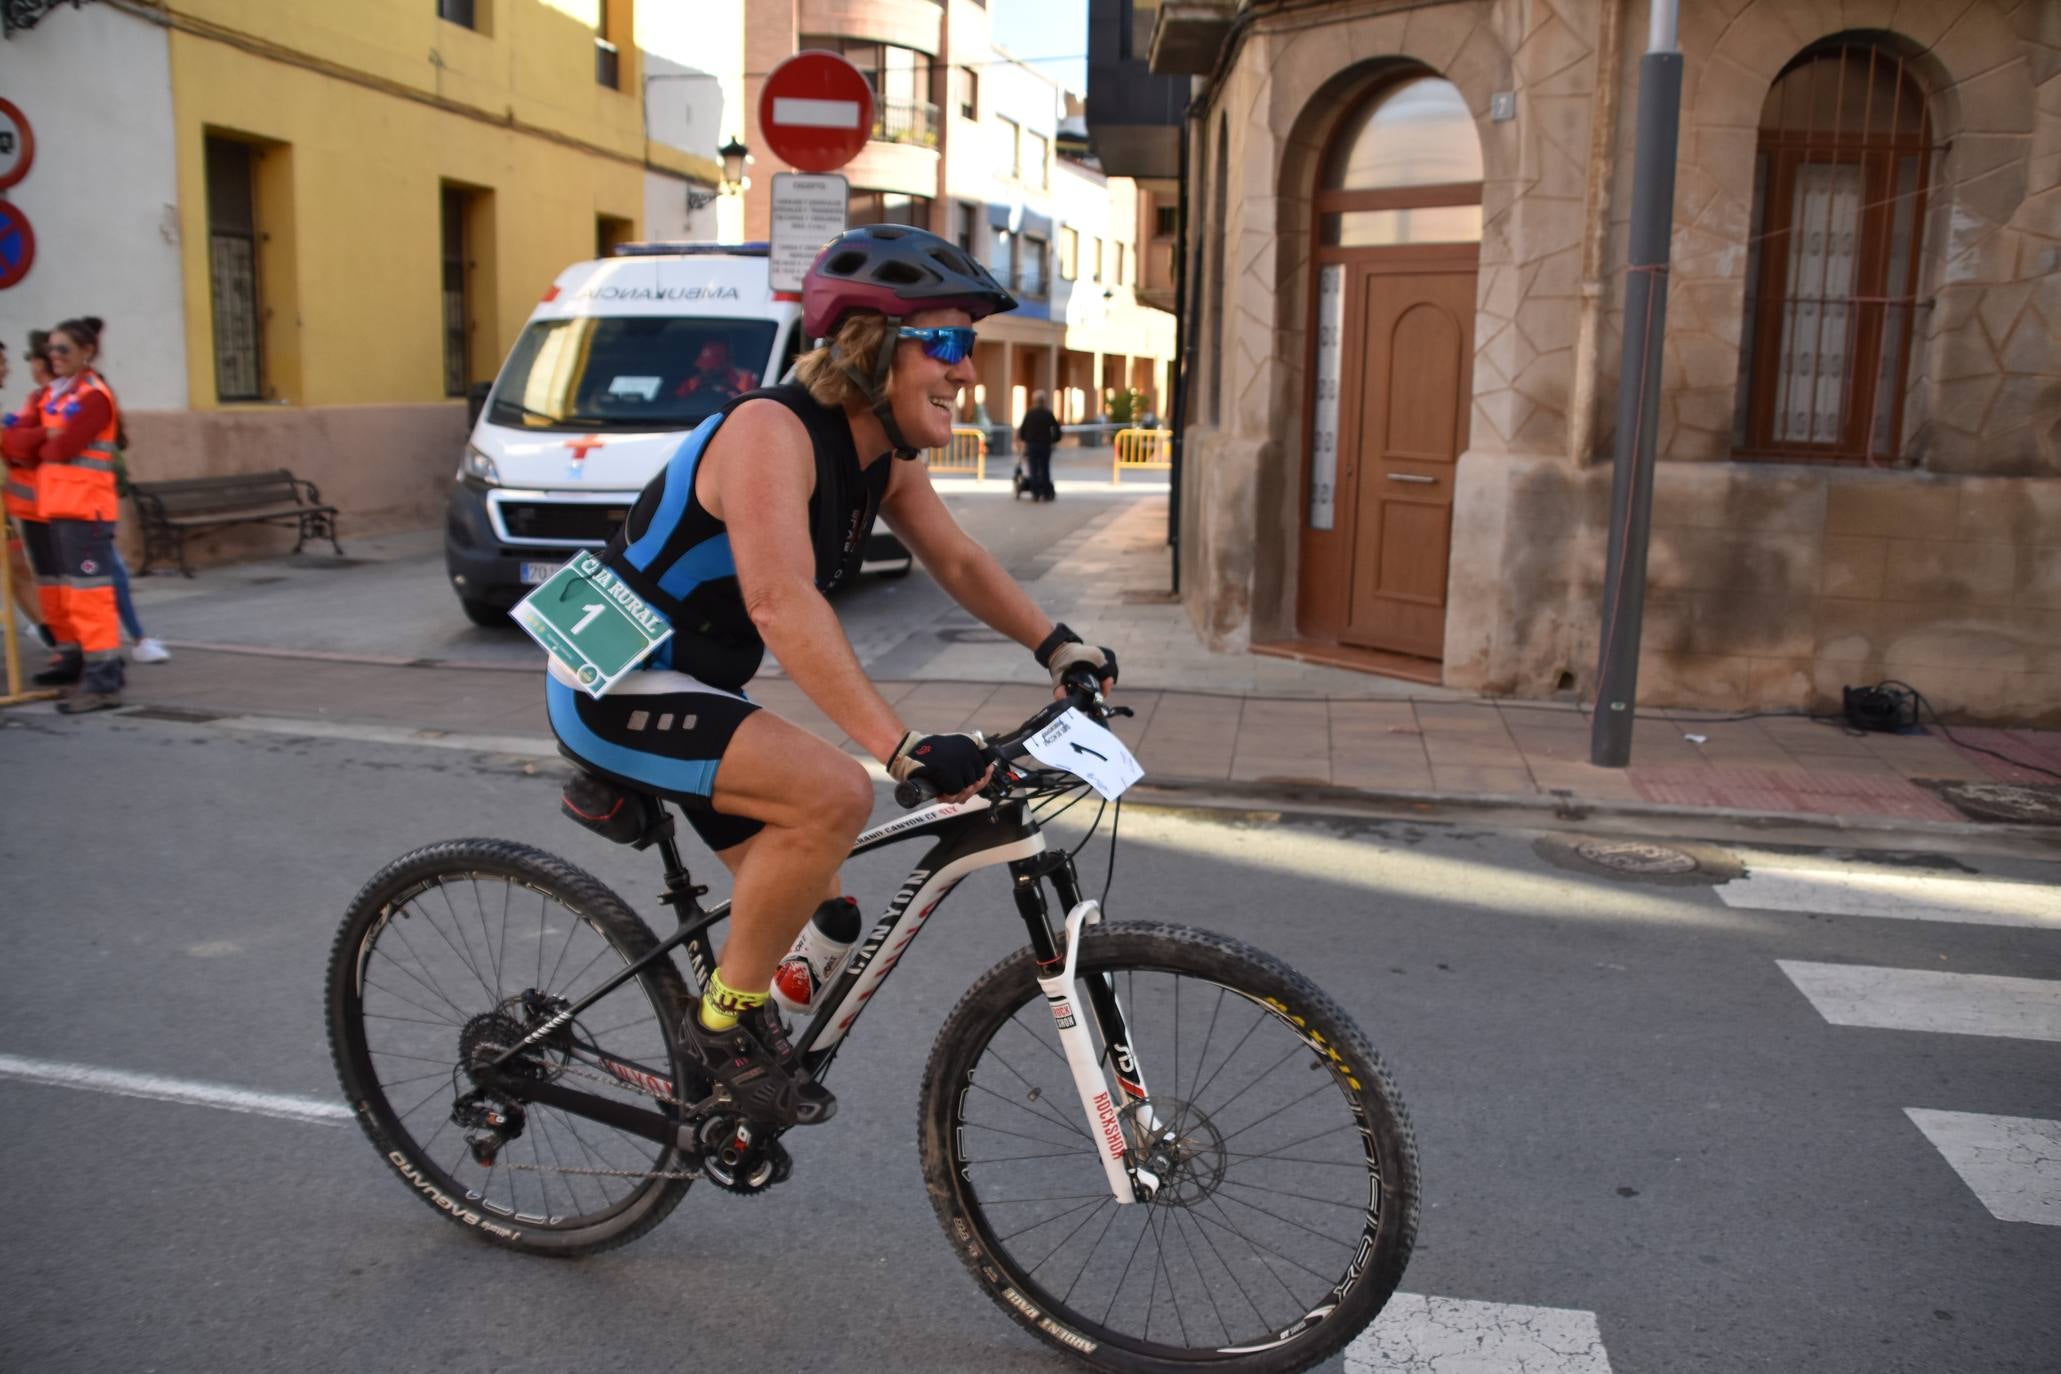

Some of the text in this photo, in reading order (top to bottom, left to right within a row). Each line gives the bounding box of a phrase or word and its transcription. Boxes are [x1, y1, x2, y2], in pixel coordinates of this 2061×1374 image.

[570, 603, 606, 635] 1
[608, 579, 662, 633] RURAL
[1070, 742, 1108, 761] 1
[885, 817, 924, 834] CANYON
[847, 869, 931, 976] CANYON
[1093, 1091, 1126, 1161] ROCKSHOX
[388, 1151, 482, 1225] SAGUARO
[1039, 1317, 1098, 1354] ARDENT
